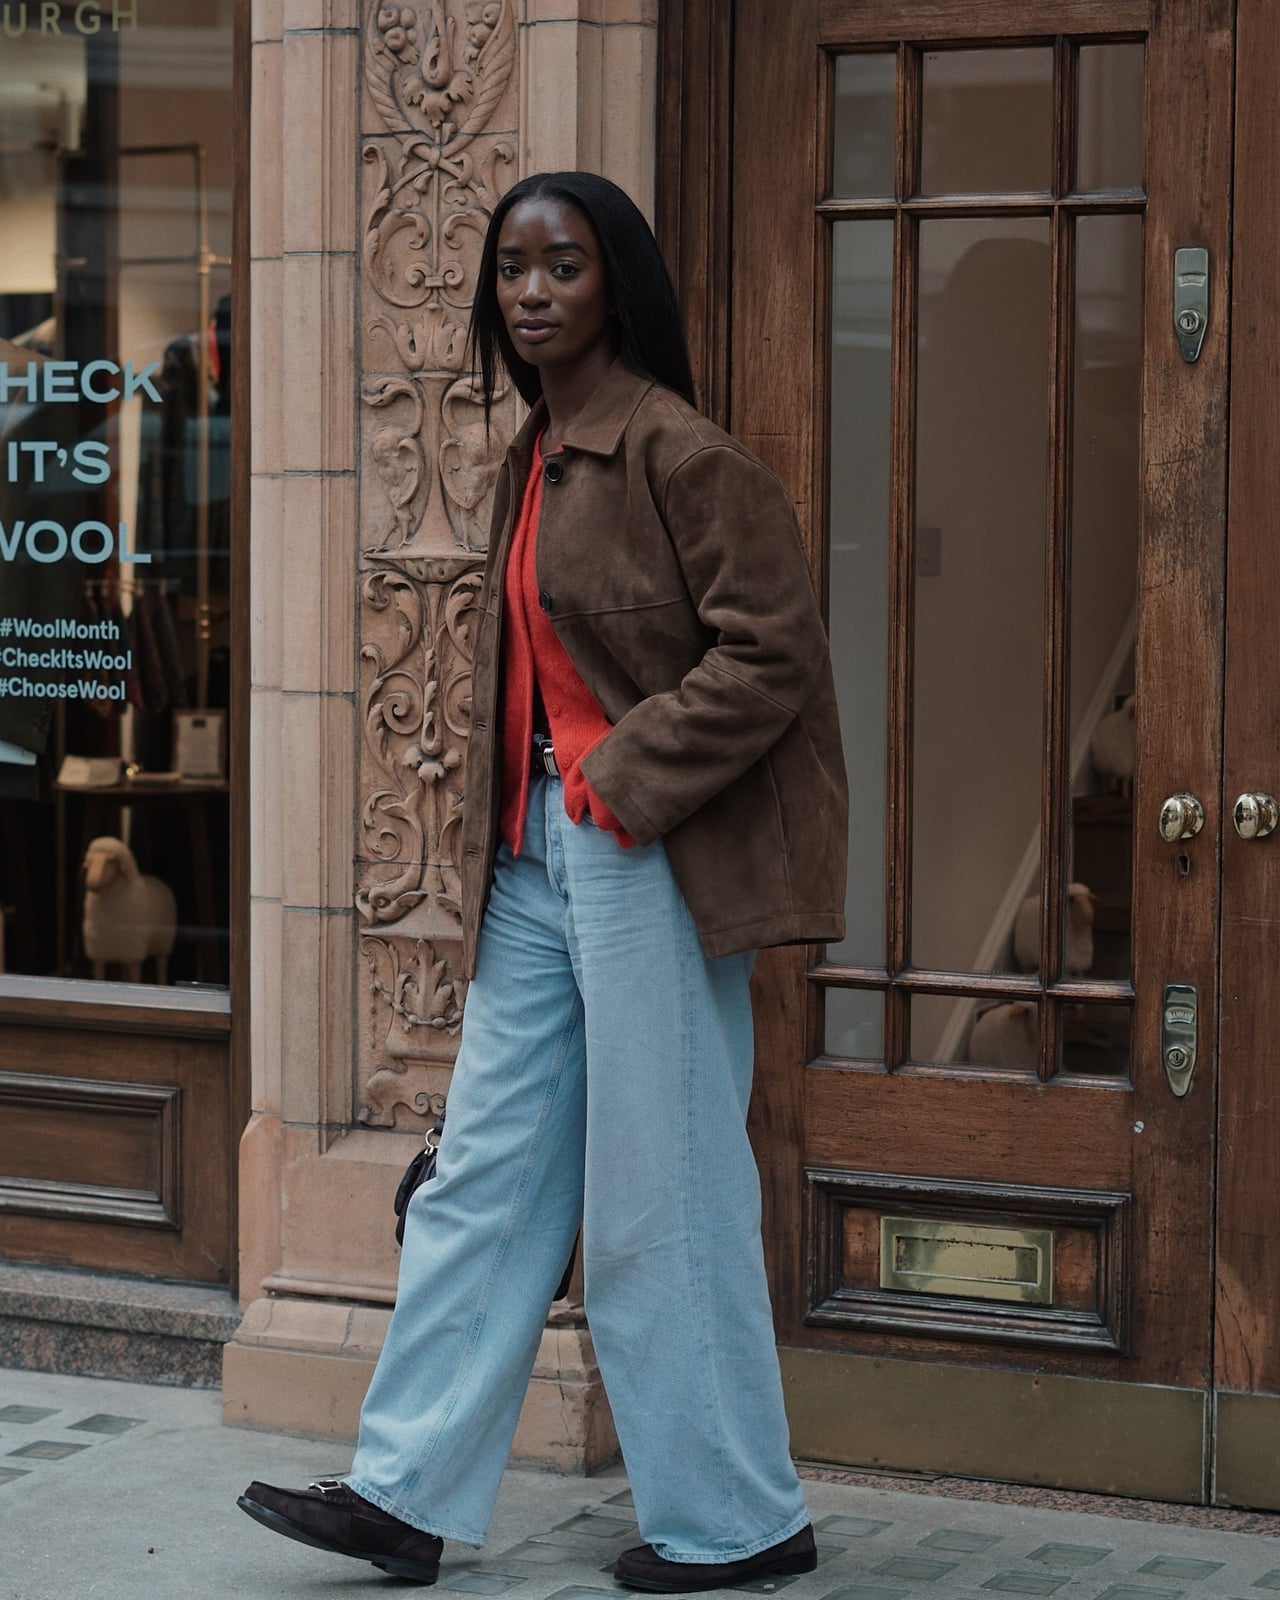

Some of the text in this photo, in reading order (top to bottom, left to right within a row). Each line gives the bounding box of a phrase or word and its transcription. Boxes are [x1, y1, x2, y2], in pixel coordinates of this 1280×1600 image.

[3, 0, 138, 37] URGH
[0, 360, 163, 403] HECK
[8, 441, 111, 484] IT’S
[0, 617, 120, 640] #WoolMonth
[0, 647, 132, 670] CheckItsWool
[0, 677, 126, 700] #ChooseWool
